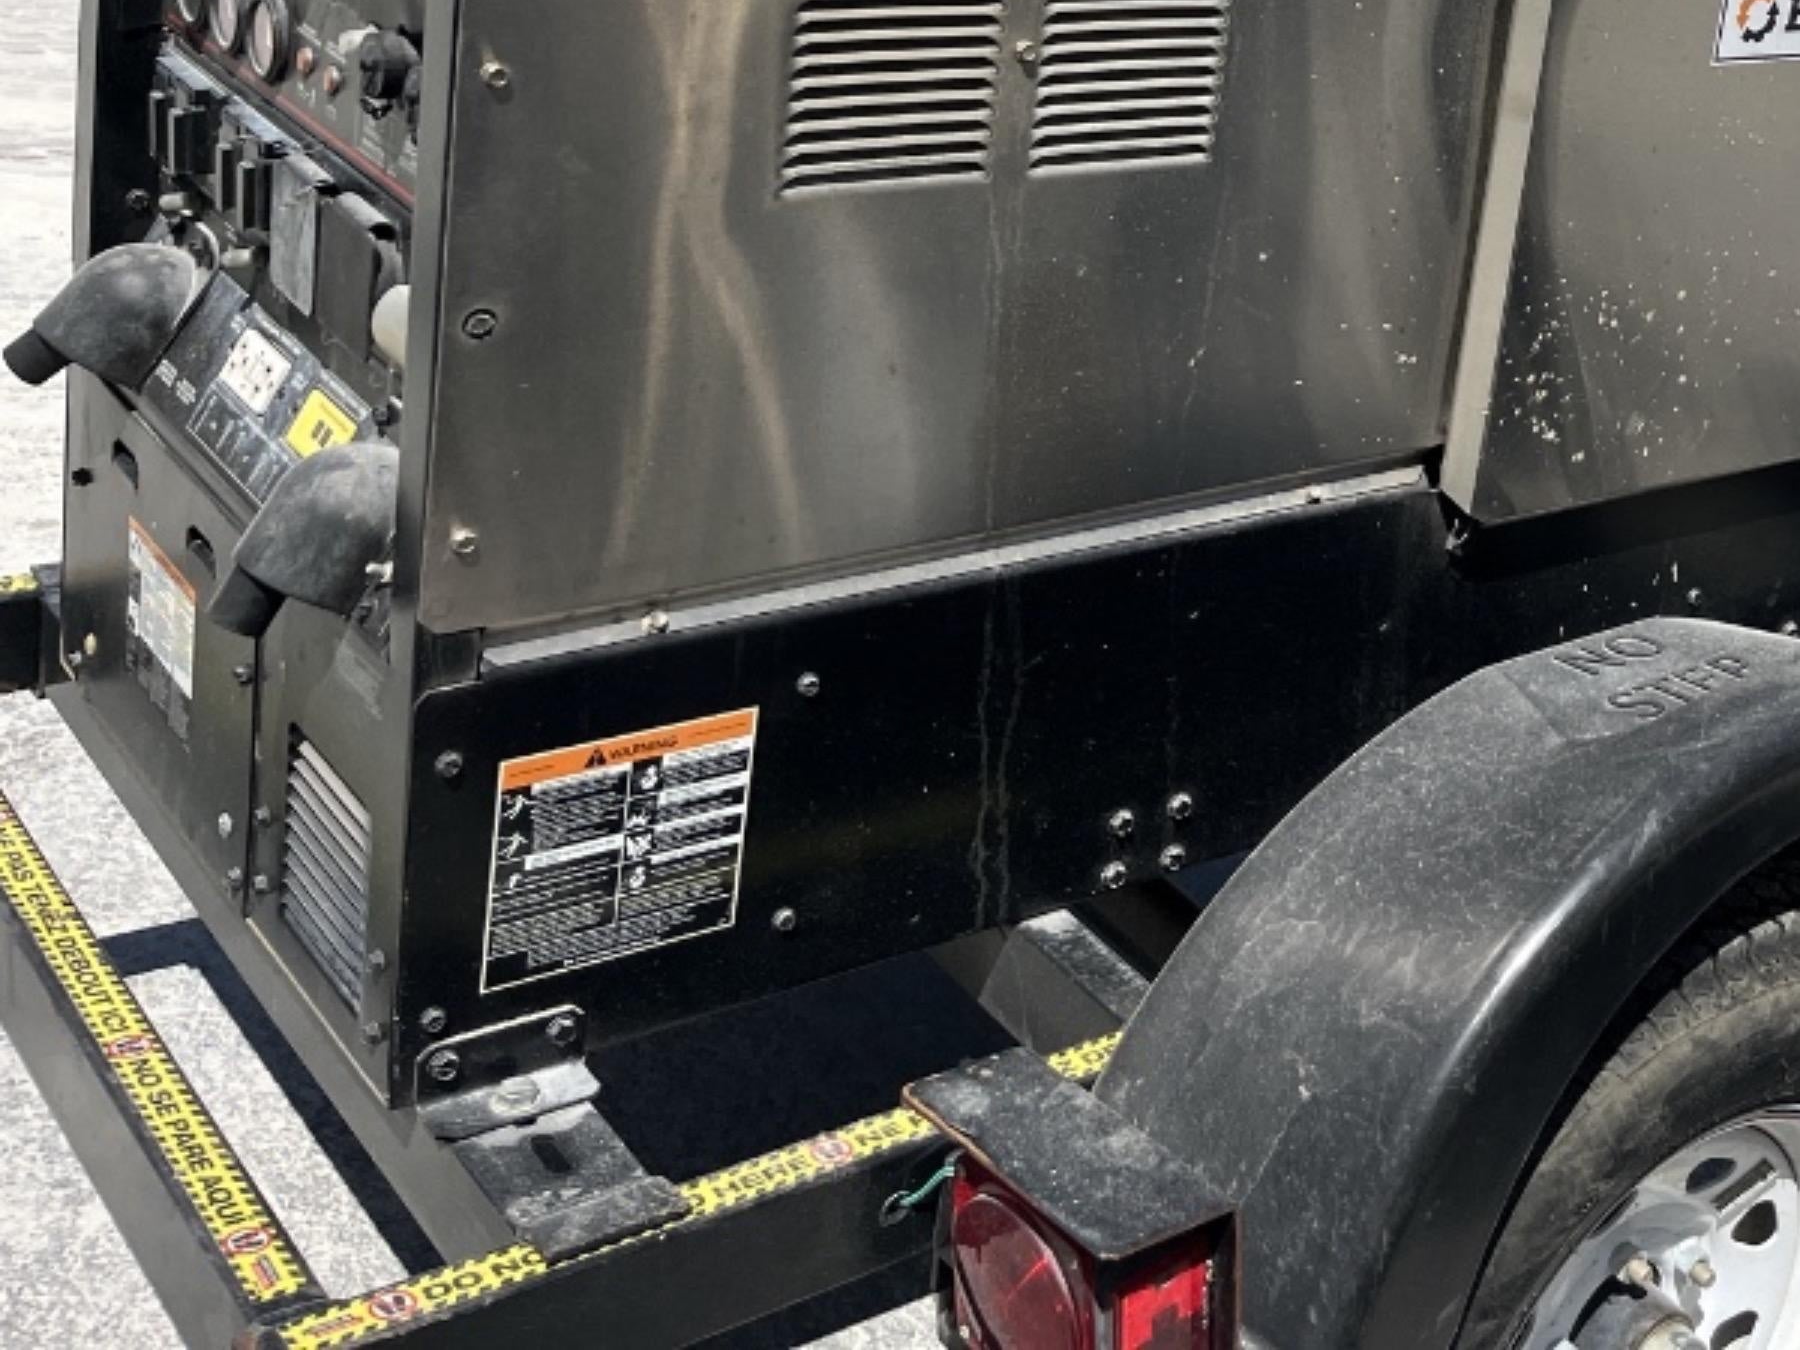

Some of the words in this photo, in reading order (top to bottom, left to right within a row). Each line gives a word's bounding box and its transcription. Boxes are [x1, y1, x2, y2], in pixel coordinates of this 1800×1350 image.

[1554, 636, 1662, 676] NO
[1608, 656, 1750, 720] STEP
[128, 1058, 162, 1087] NO
[147, 1089, 181, 1118] SE
[164, 1118, 215, 1173] PARE
[422, 1271, 484, 1299] DO
[490, 1251, 543, 1277] NO
